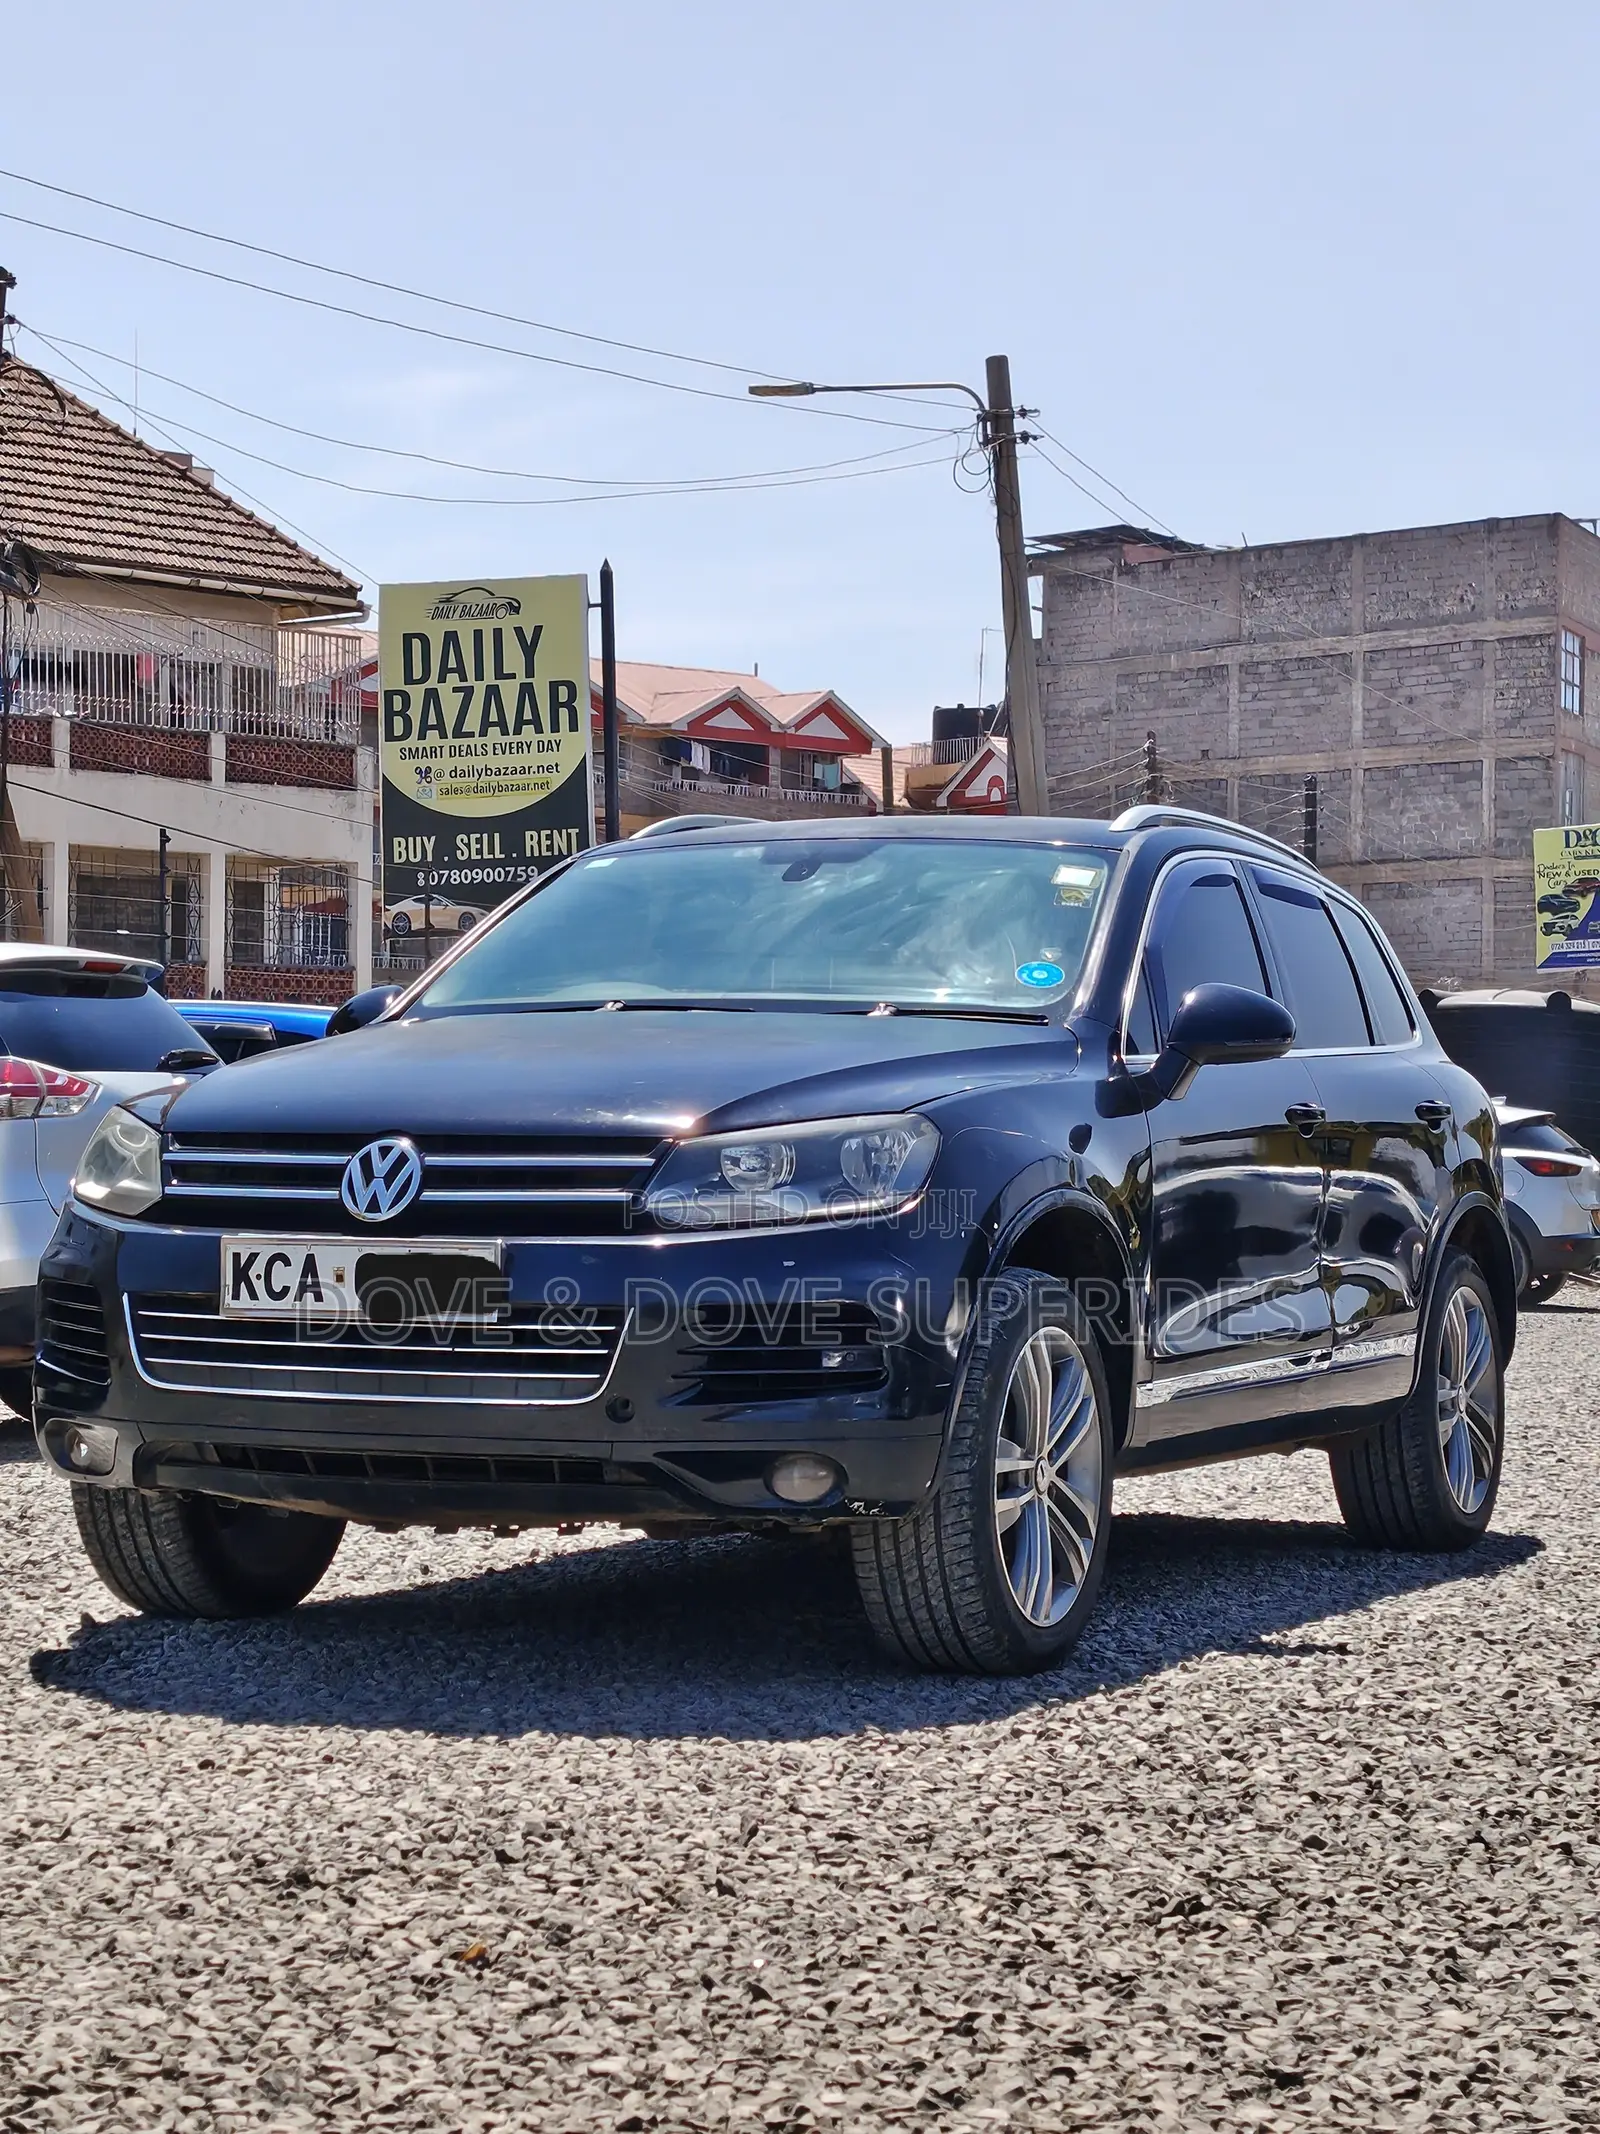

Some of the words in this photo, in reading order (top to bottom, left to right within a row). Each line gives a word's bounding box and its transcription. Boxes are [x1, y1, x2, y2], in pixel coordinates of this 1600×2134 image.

[431, 604, 459, 620] DAILY
[459, 602, 497, 618] BAZAAR
[402, 625, 543, 685] DAILY
[384, 680, 579, 742] BAZAAR
[399, 745, 445, 761] SMART
[449, 743, 488, 758] DEALS
[492, 741, 533, 756] EVERY
[537, 739, 562, 754] DAY
[449, 762, 561, 783] dailybazaar.net
[439, 780, 551, 796] sales@dailybazaar.net
[393, 836, 436, 863] BUY
[456, 833, 505, 861] SELL
[525, 828, 579, 857] RENT
[429, 866, 539, 885] 0780900759
[1538, 871, 1561, 879] NEW
[1548, 877, 1567, 889] Cars
[341, 1138, 423, 1222] VW
[231, 1251, 325, 1303] KCA
